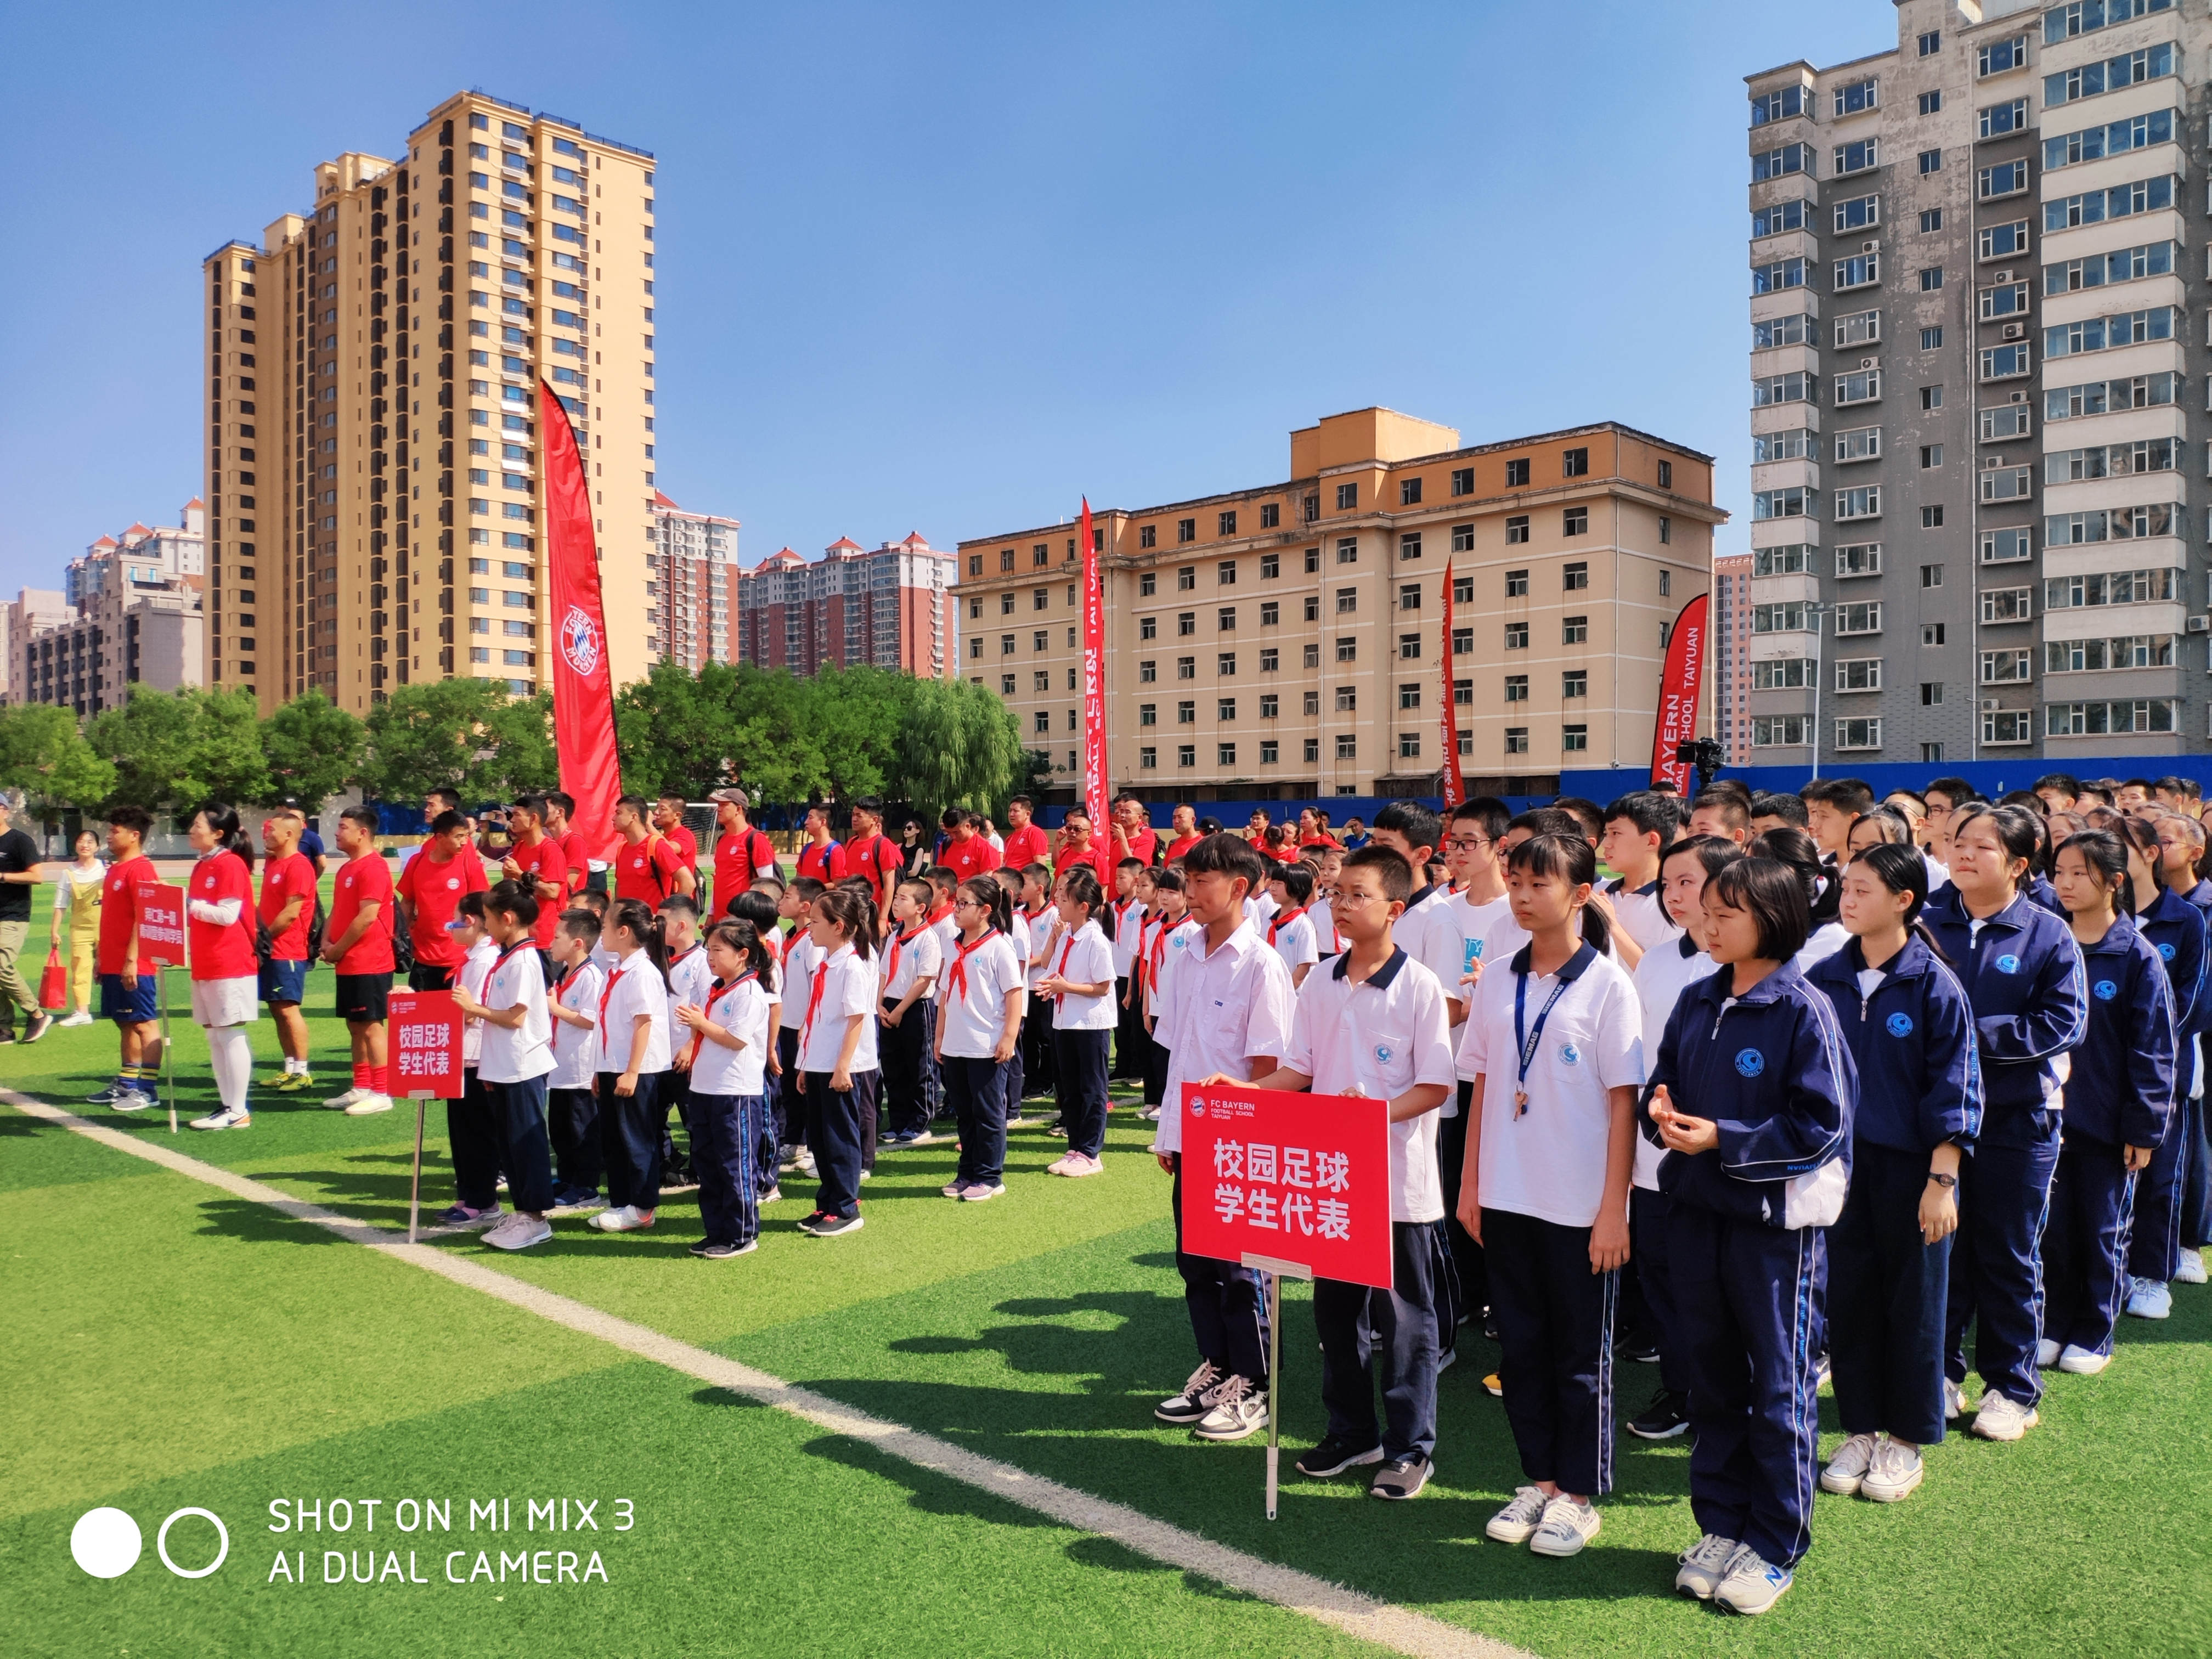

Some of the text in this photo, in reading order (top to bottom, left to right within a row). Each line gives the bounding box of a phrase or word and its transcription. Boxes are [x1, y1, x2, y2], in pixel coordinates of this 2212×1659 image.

[1684, 627, 1699, 690] TAIYUAN
[1680, 695, 1694, 741] CHOOL
[399, 1023, 450, 1048] 校园足球
[399, 1051, 449, 1076] 学生代表
[1211, 1099, 1221, 1108] FC
[1222, 1101, 1255, 1111] BAYERN
[1214, 1138, 1350, 1193] 校园足球
[1214, 1183, 1351, 1242] 学生代表
